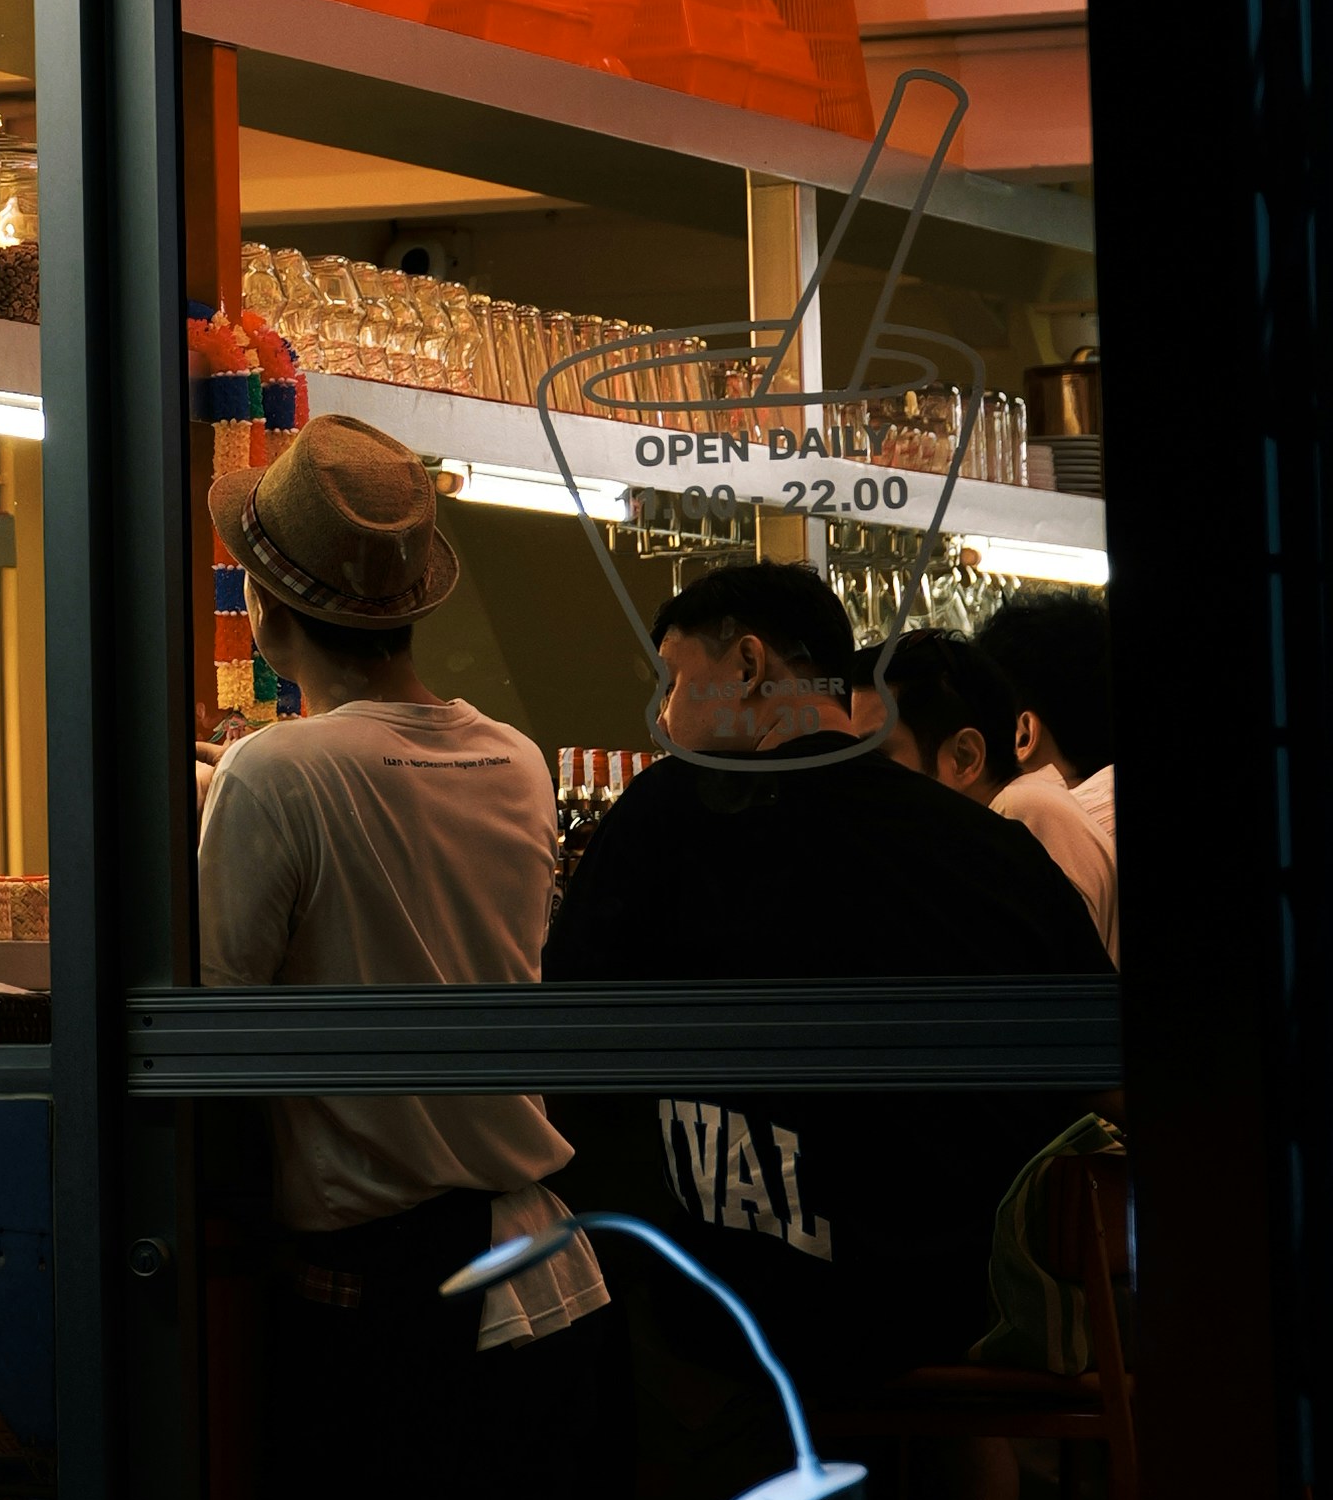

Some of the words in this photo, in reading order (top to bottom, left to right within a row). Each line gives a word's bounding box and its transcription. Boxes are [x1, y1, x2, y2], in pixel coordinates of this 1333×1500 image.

[635, 431, 749, 467] OPEN
[768, 423, 891, 462] DAILY
[781, 476, 909, 514] 22.00
[760, 676, 847, 698] ORDER
